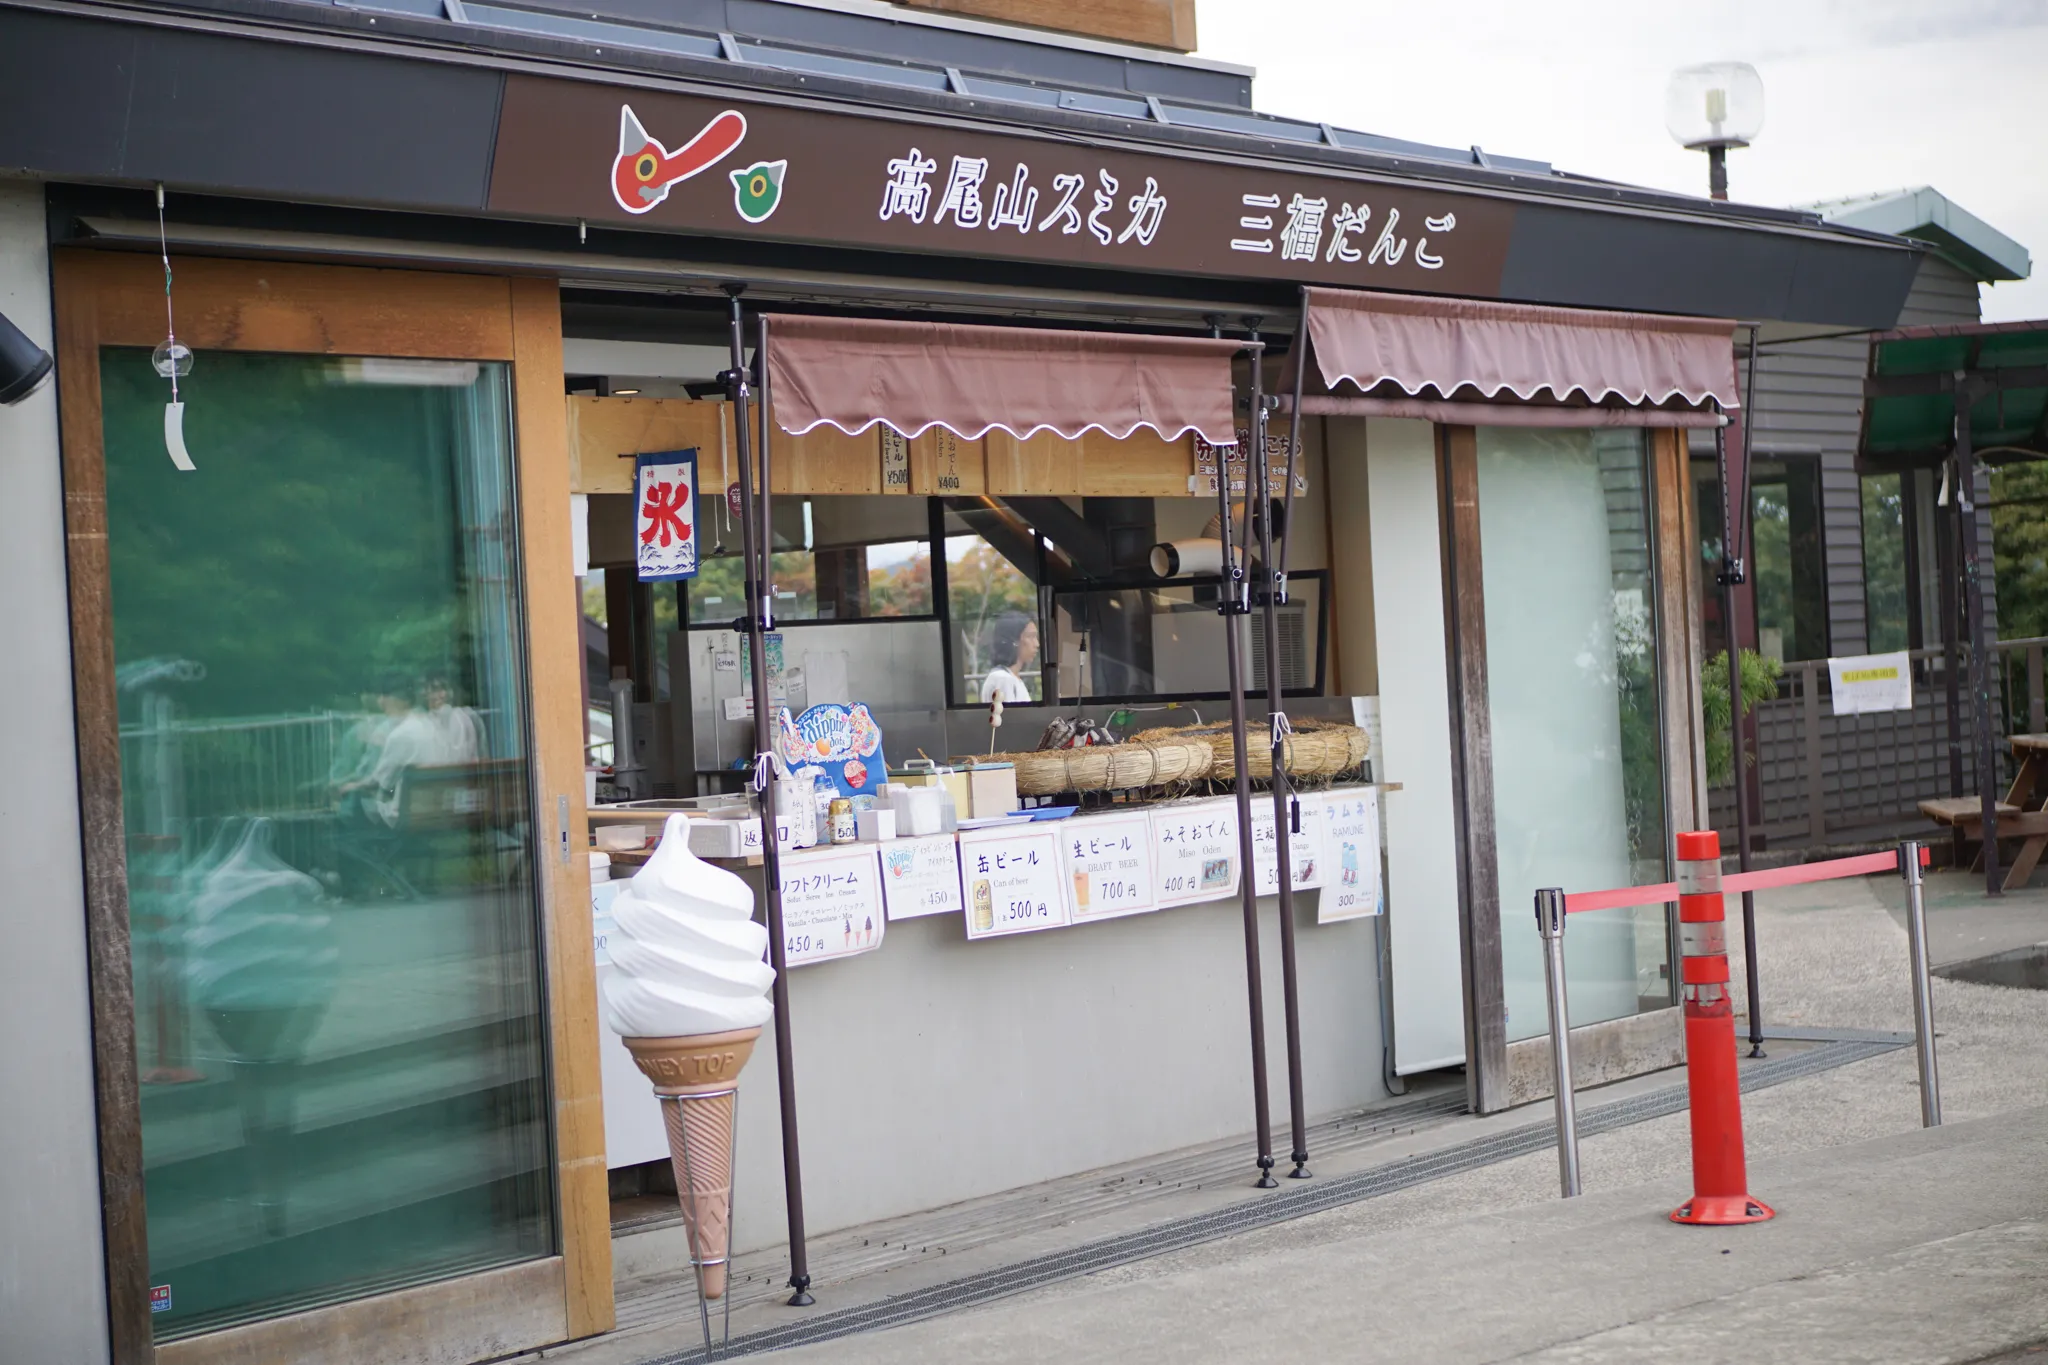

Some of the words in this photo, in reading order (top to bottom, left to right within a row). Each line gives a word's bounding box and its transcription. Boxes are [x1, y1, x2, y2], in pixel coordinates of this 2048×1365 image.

[879, 147, 1167, 245] 高尾山スミカ
[1230, 192, 1456, 269] 三福だんご
[640, 481, 692, 548] 氷
[1327, 801, 1365, 820] ラムネ
[744, 826, 788, 847] 返口
[1163, 820, 1229, 843] みそおでん
[1332, 824, 1365, 838] RAMUNE
[1073, 836, 1132, 858] 生ビール
[1178, 848, 1196, 859] Miso
[1202, 845, 1222, 856] Oden
[977, 850, 1039, 873] 缶ビール
[1088, 862, 1113, 873] DRAFT
[1118, 859, 1139, 869] BEER
[993, 880, 1007, 888] Can
[1016, 877, 1029, 885] beer
[1338, 894, 1354, 907] 300
[692, 1051, 735, 1075] TOP
